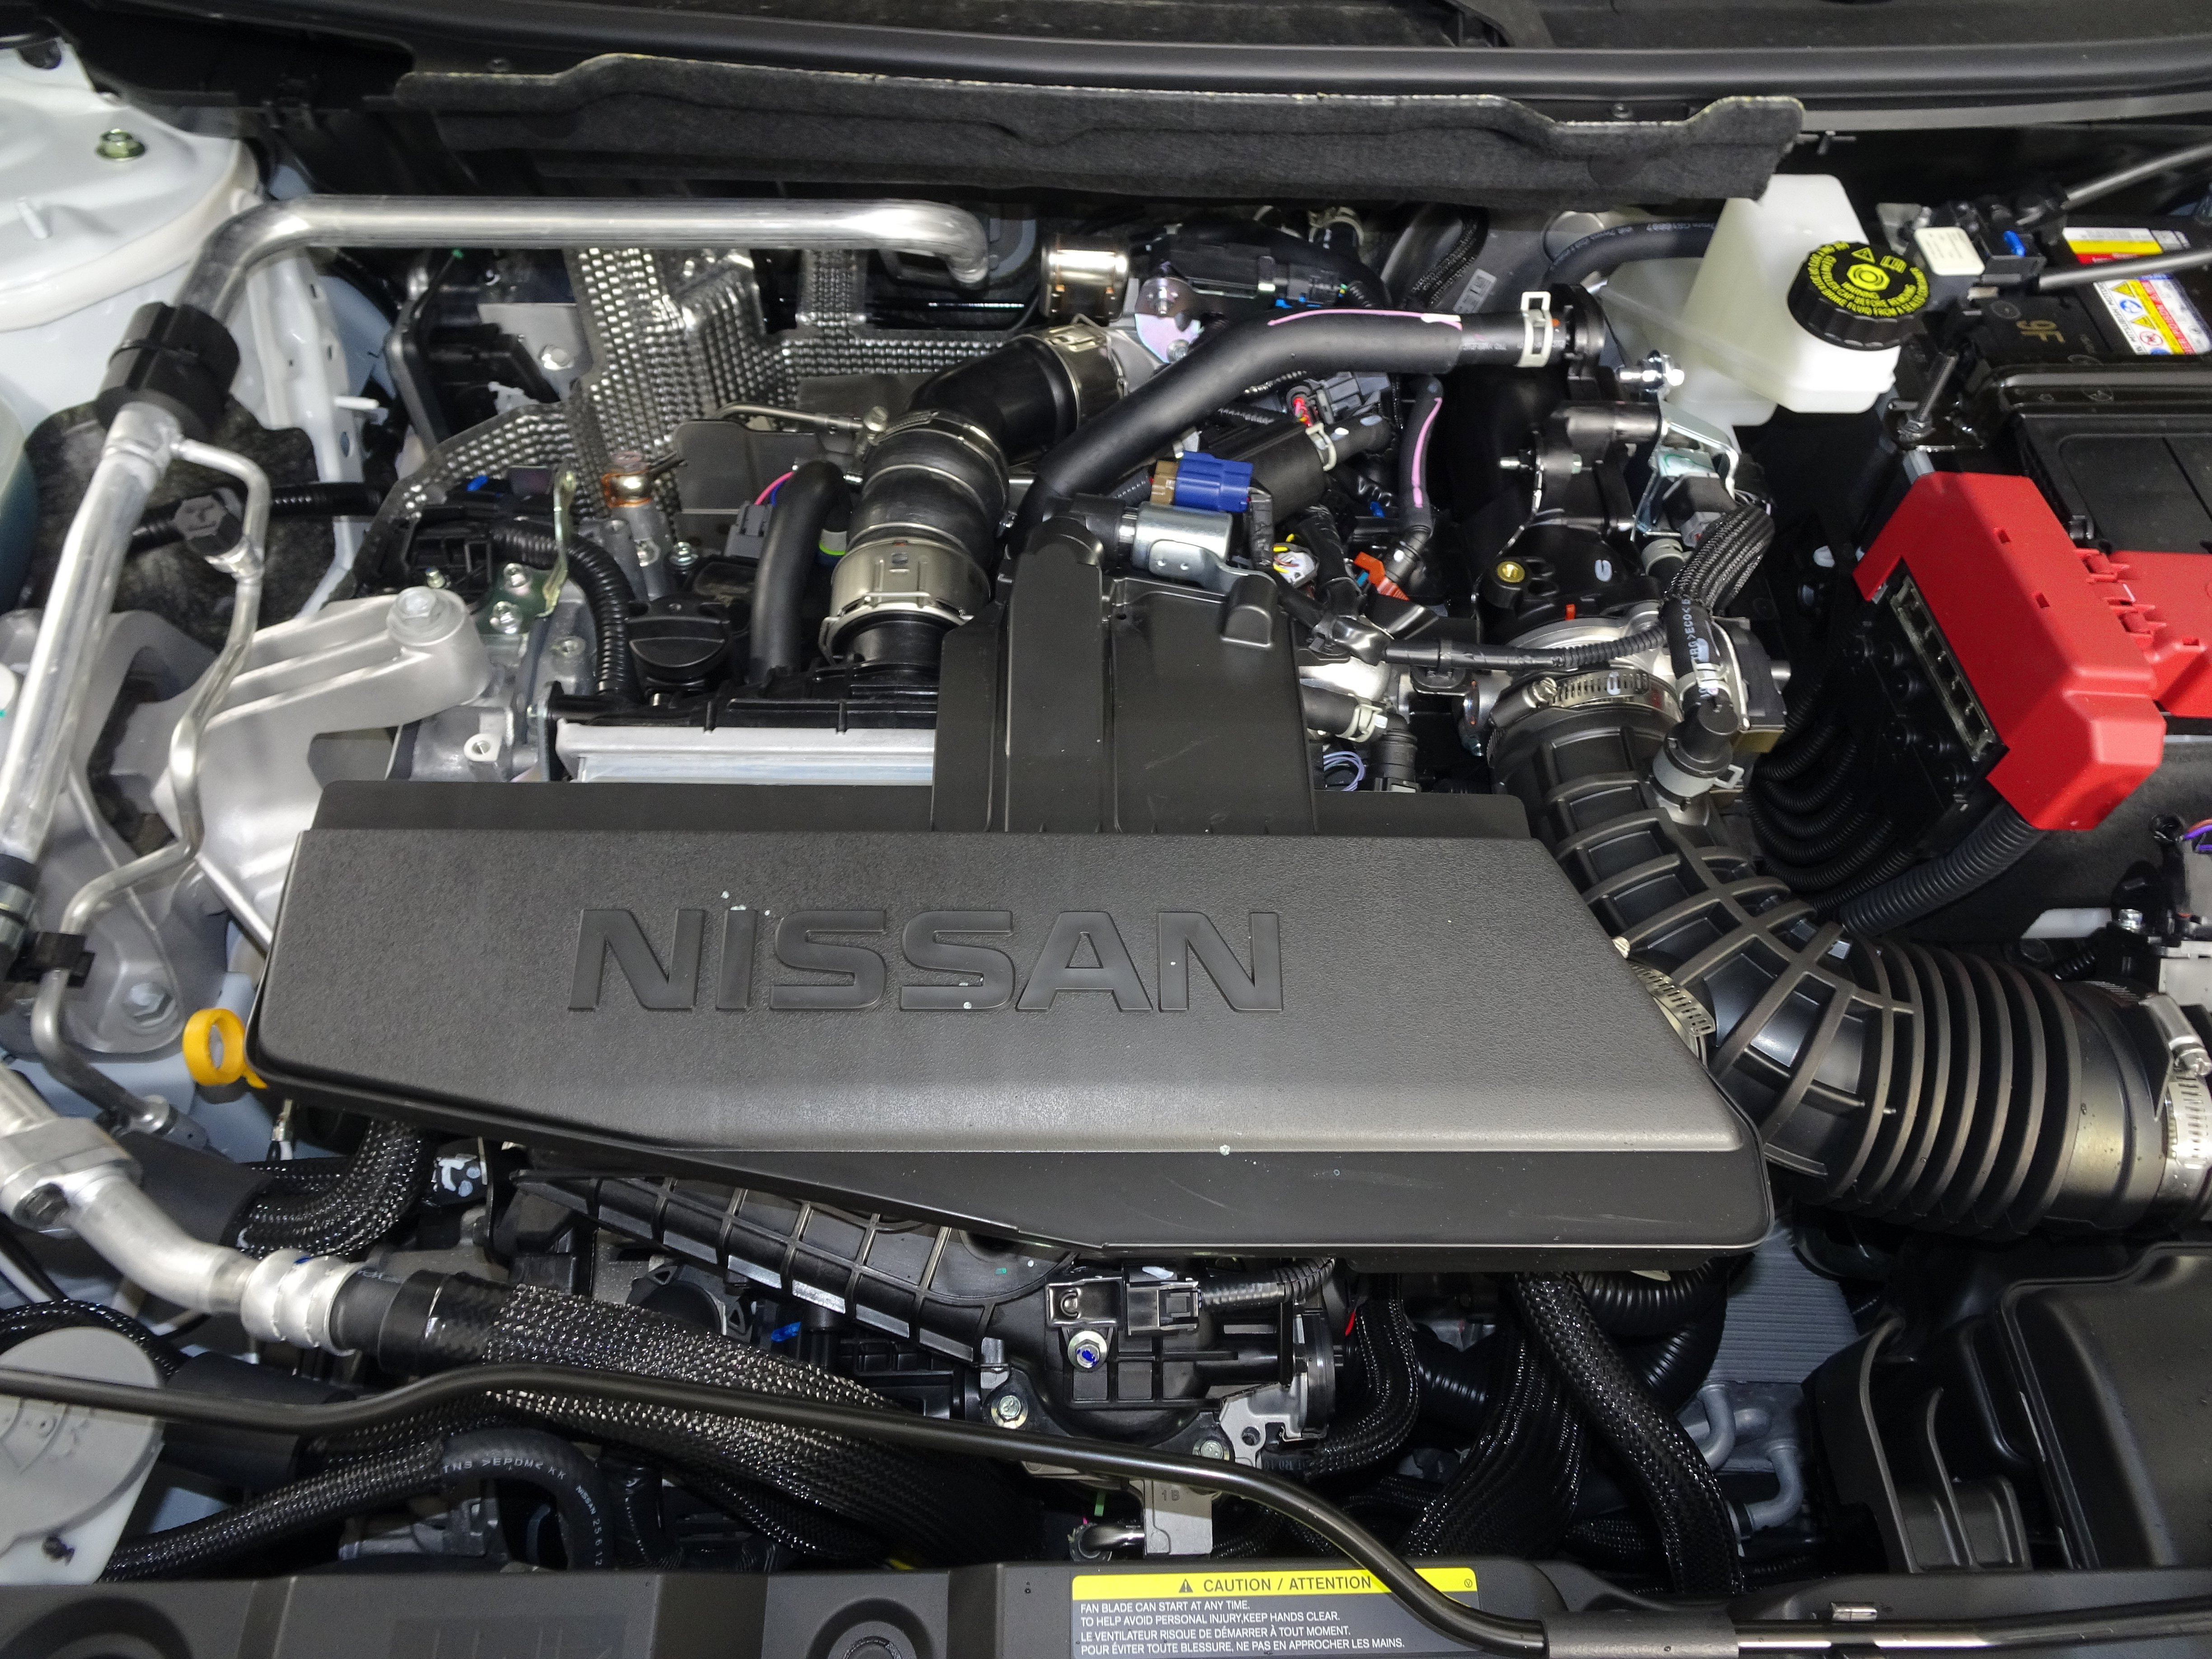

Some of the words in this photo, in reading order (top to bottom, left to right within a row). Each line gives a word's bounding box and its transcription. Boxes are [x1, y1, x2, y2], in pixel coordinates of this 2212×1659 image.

[567, 907, 1285, 1013] NISSAN
[576, 1485, 597, 1515] NISSAN
[1204, 1578, 1271, 1592] CAUTION
[1277, 1578, 1284, 1590] /
[1289, 1576, 1371, 1590] ATTENTION
[1081, 1603, 1099, 1614] FAN
[1101, 1603, 1133, 1613] BLADE
[1135, 1602, 1156, 1613] CAN
[1159, 1601, 1188, 1612] START
[1190, 1601, 1201, 1611] AT
[1204, 1600, 1223, 1611] ANY
[1226, 1600, 1250, 1610] TIME.
[1081, 1616, 1094, 1627] TO
[1097, 1615, 1121, 1626] HELP
[1124, 1615, 1153, 1626] AVOID
[1156, 1613, 1207, 1625] PERSONAL
[1270, 1611, 1304, 1622] HANDS
[1307, 1611, 1340, 1621] CLEAR.
[1081, 1631, 1092, 1642] LE
[1095, 1630, 1158, 1642] VENTILATEUR
[1160, 1629, 1196, 1640] RISQUE
[1199, 1629, 1212, 1639] DE
[1214, 1626, 1268, 1639] DÉMARRER
[1270, 1624, 1277, 1637] À
[1279, 1626, 1303, 1637] TOUT
[1307, 1626, 1350, 1636] MOMENT.
[1081, 1644, 1109, 1655] POUR
[1112, 1641, 1145, 1655] ÉVITER
[1147, 1643, 1178, 1654] TOUTE
[1181, 1641, 1234, 1653] BLESSURE,
[1236, 1641, 1249, 1651] NE
[1252, 1640, 1271, 1651] PAS
[1273, 1640, 1286, 1650] EN
[1289, 1639, 1350, 1650] APPROCHER
[1352, 1638, 1369, 1649] LES
[1372, 1638, 1405, 1648] MAINS.
